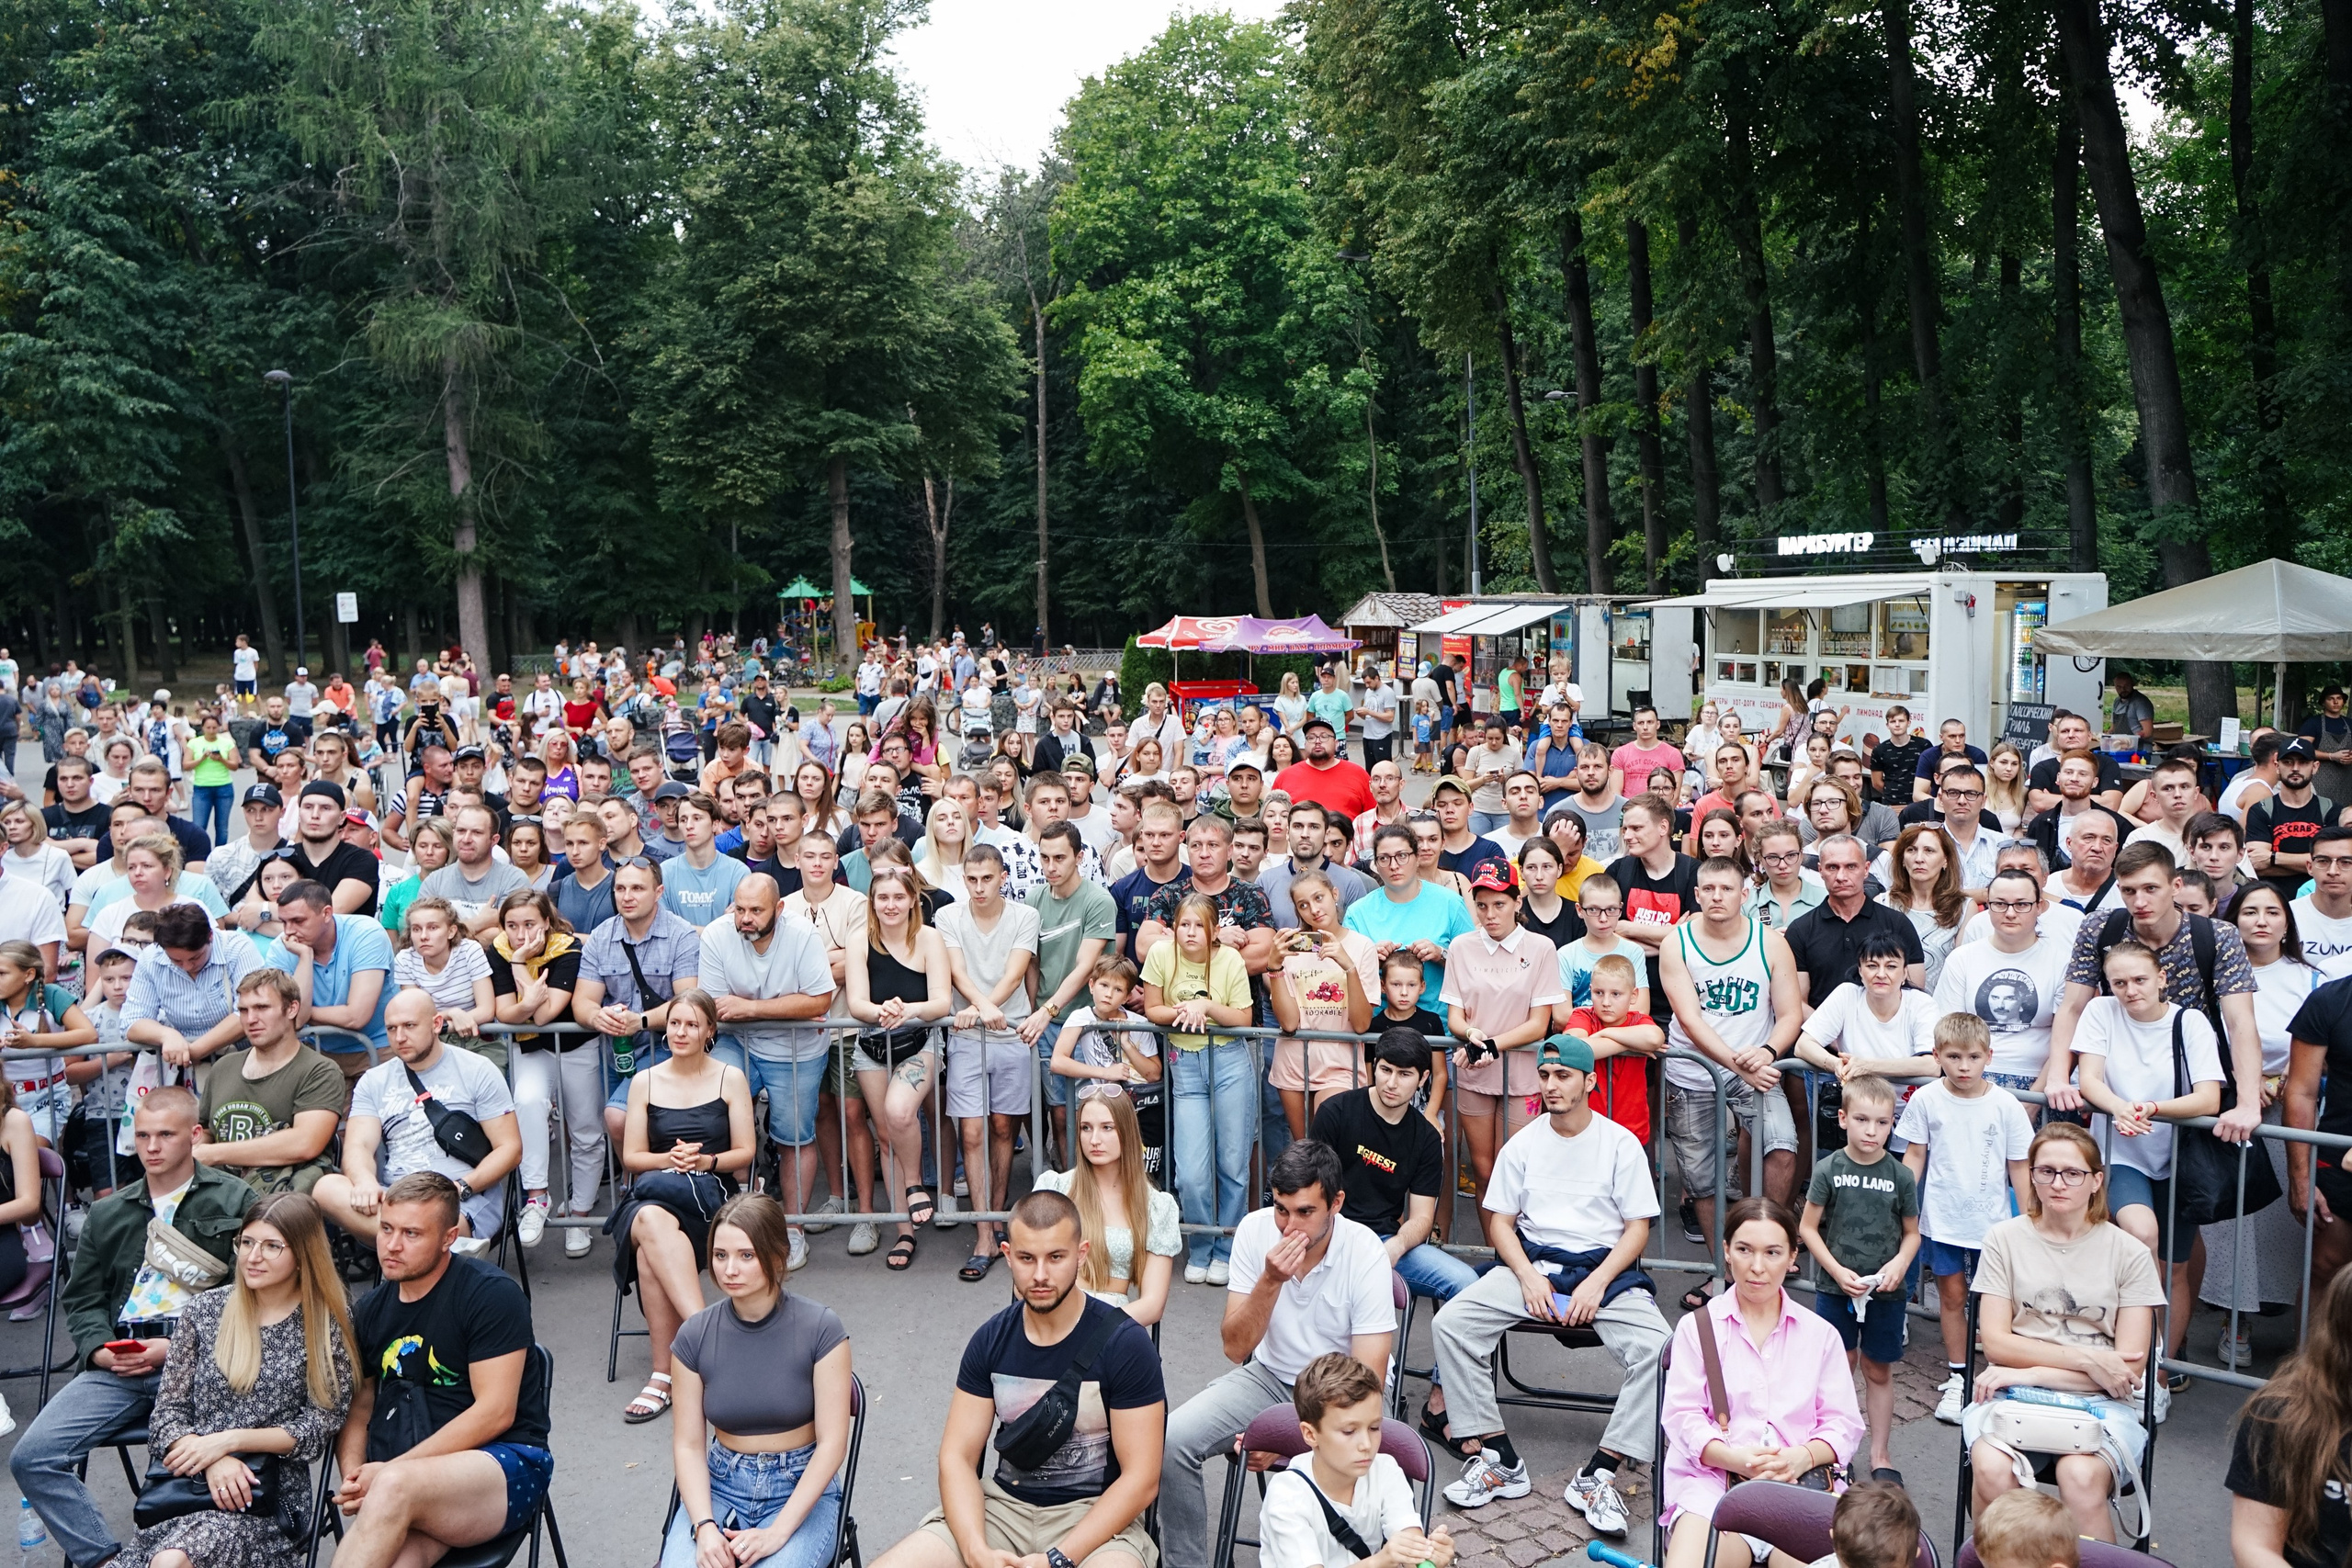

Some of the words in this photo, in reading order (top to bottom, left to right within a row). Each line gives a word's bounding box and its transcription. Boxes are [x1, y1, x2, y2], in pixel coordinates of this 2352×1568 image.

[1778, 532, 1874, 555] ПАРКБУРГЕР
[1733, 699, 1755, 707] ХОТ-ДОГИ
[1856, 708, 1883, 718] ЛИМОНАД
[2010, 705, 2053, 720] КЛАССИЧЕСКИЙ
[2005, 717, 2030, 734] ГРИЛЬ
[1626, 759, 1642, 769] WEST
[1635, 908, 1657, 921] JUST
[1656, 911, 1671, 923] DO
[1694, 976, 1754, 995] LEAGUE
[1706, 982, 1759, 1011] 903
[1136, 1096, 1159, 1106] FILA
[250, 1104, 264, 1115] STREET
[229, 1114, 254, 1142] B
[1979, 1139, 1994, 1192] PlayStation
[1862, 1176, 1894, 1192] LAND
